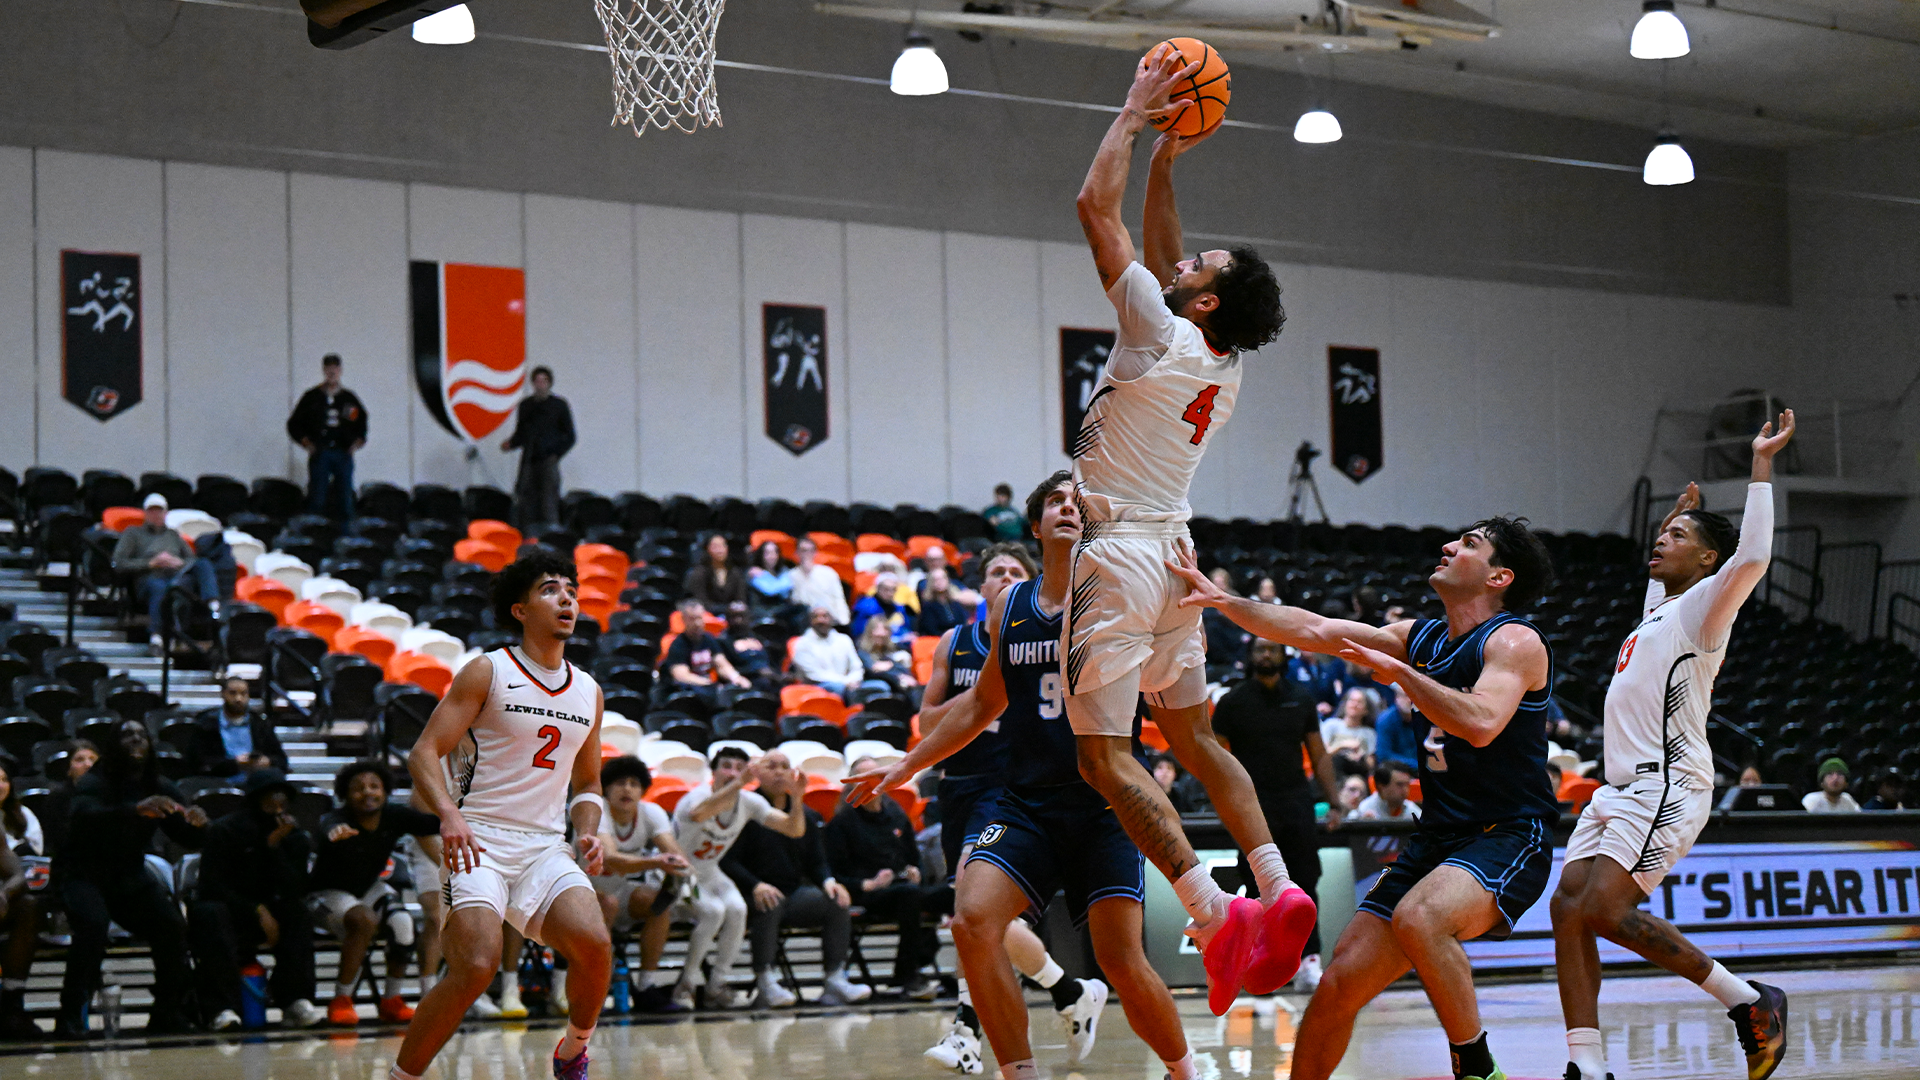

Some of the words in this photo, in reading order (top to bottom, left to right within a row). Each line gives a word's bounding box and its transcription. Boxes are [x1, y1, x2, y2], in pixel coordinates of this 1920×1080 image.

[1181, 384, 1222, 447] 4
[504, 703, 546, 716] LEWIS
[546, 709, 555, 718] &
[555, 710, 590, 728] CLARK
[1038, 671, 1063, 720] 9
[532, 723, 562, 771] 2
[1423, 726, 1448, 773] 5
[1742, 867, 1866, 917] HEAR
